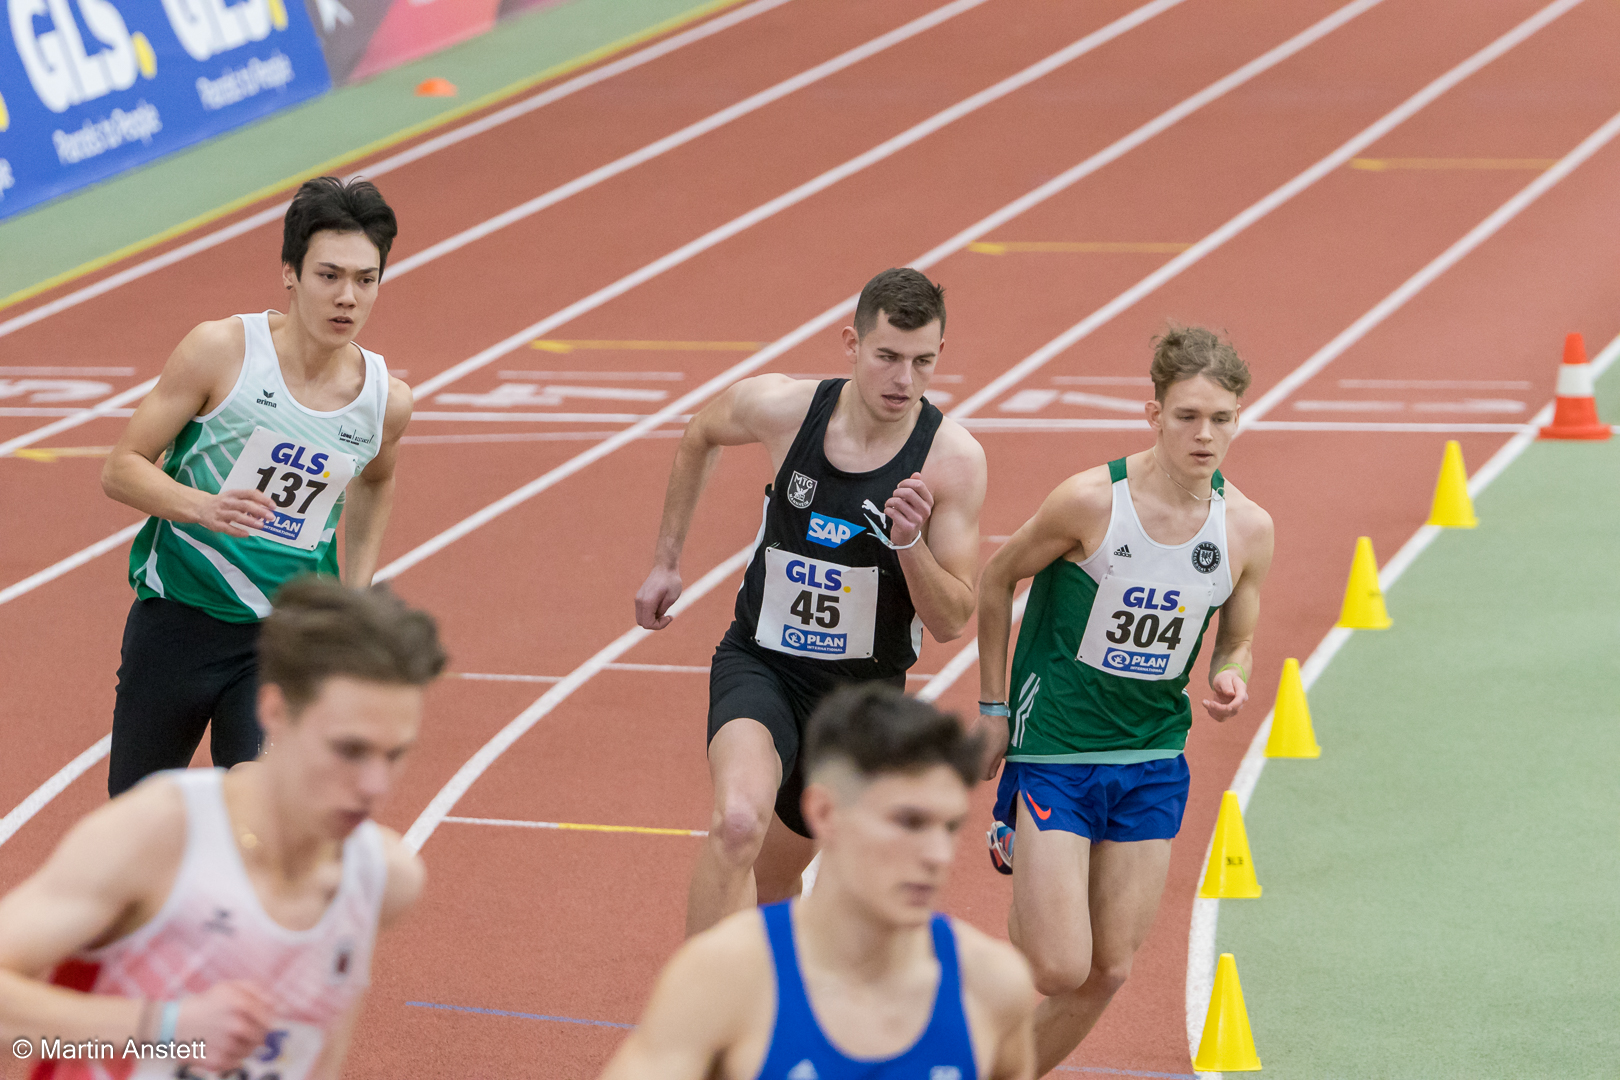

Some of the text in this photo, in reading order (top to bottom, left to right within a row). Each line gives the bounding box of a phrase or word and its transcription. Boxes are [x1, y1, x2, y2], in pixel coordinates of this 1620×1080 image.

[256, 398, 277, 409] erima
[793, 473, 813, 489] MTG
[256, 466, 328, 515] 137
[808, 517, 851, 544] SAP
[1114, 550, 1132, 559] adidas
[790, 589, 840, 629] 45
[1105, 610, 1185, 650] 304
[807, 634, 844, 648] PLAN
[1130, 665, 1163, 673] INTERNATIONAL
[1131, 655, 1167, 668] PLAN
